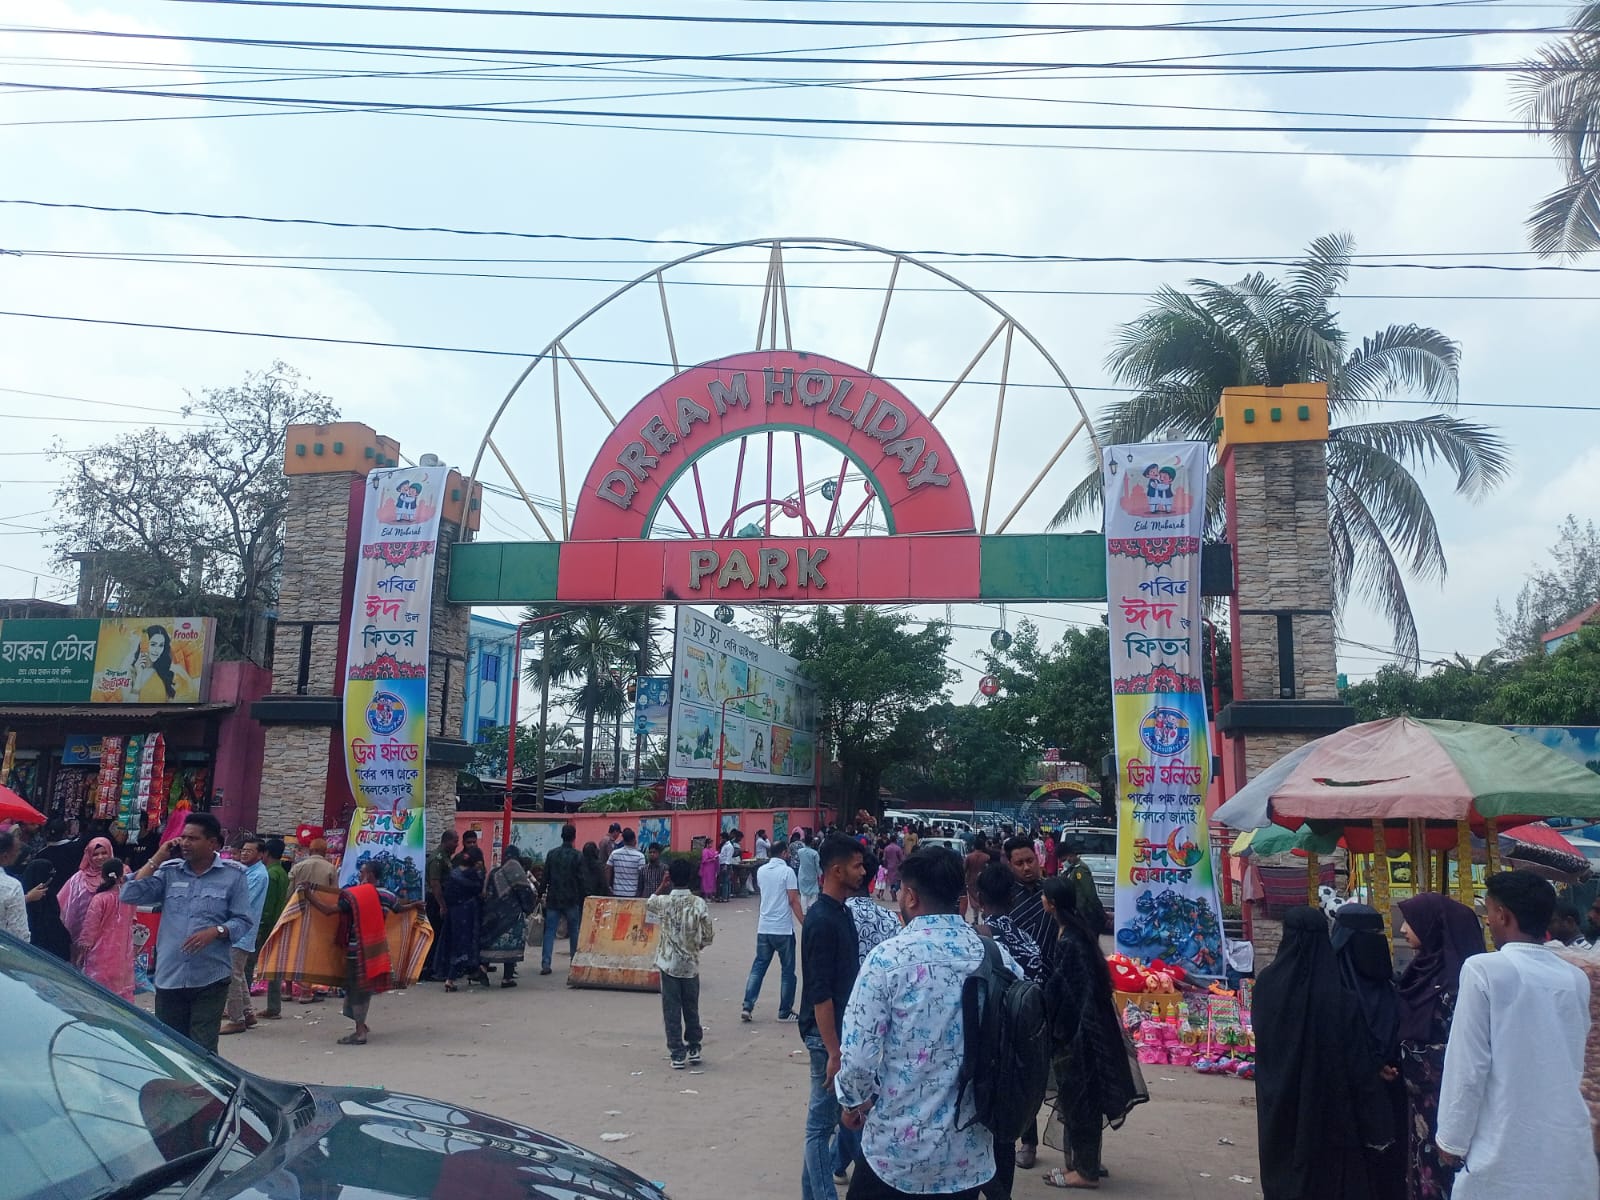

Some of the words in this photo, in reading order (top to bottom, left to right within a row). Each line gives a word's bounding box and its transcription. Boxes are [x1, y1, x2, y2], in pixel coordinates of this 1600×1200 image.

[595, 372, 751, 511] DREAM
[763, 366, 951, 492] HOLIDAY
[381, 527, 394, 537] Eid
[394, 526, 422, 537] Mubarak
[1134, 520, 1149, 531] Eid
[1150, 519, 1186, 531] Mubarak
[688, 547, 829, 590] PARK
[377, 575, 418, 593] পবিত্র
[364, 594, 405, 622] ঈদ
[1119, 595, 1177, 631] ঈদ
[2, 640, 48, 662] হারুন
[51, 634, 97, 661] স্টোর
[351, 737, 376, 764] ড্রিম
[380, 737, 418, 761] হলিডে
[1126, 758, 1155, 787] ড্রিম
[1159, 758, 1201, 785] হলিডে
[1133, 838, 1169, 867] ঈদ
[1129, 866, 1192, 886] মোবারক
